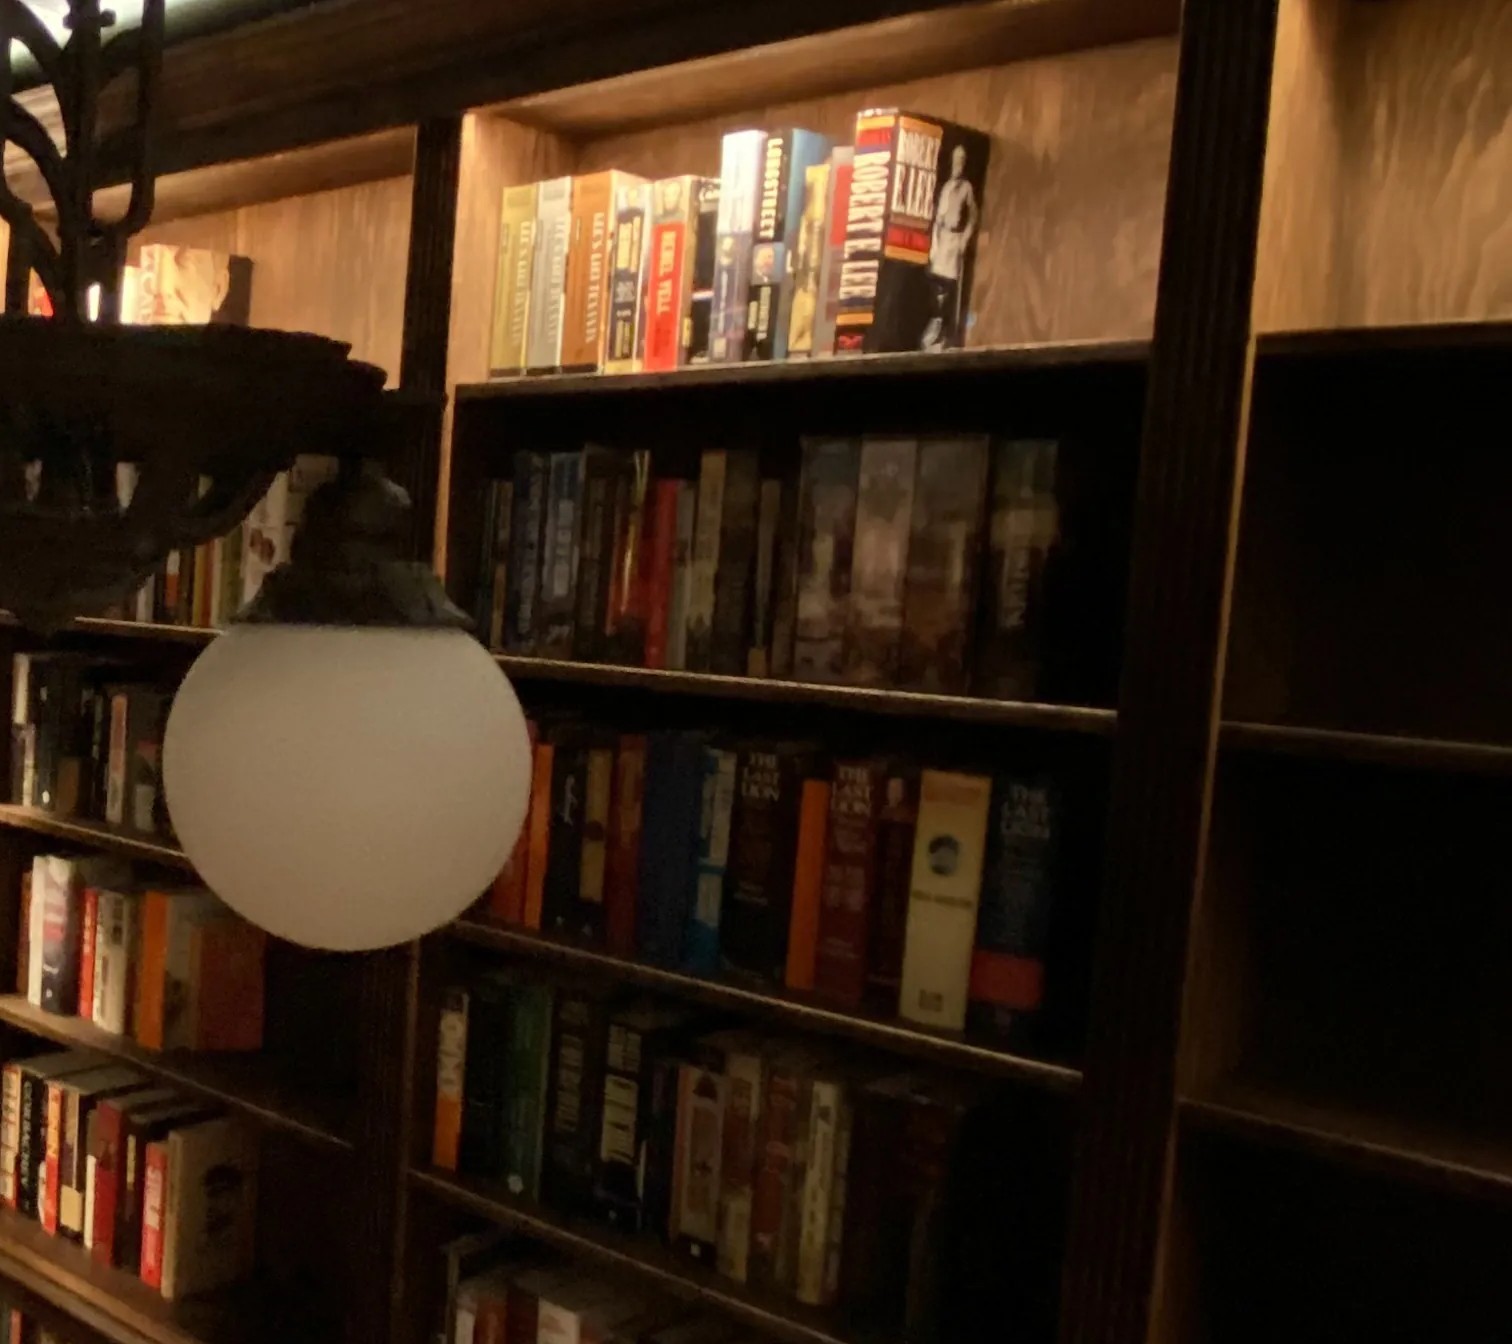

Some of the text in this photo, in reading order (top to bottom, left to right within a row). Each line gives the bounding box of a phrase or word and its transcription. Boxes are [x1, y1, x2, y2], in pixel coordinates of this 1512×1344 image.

[759, 137, 784, 239] LONGSTREET
[846, 150, 891, 233] ROBERT
[656, 278, 673, 316] YELL
[839, 259, 880, 299] LEE
